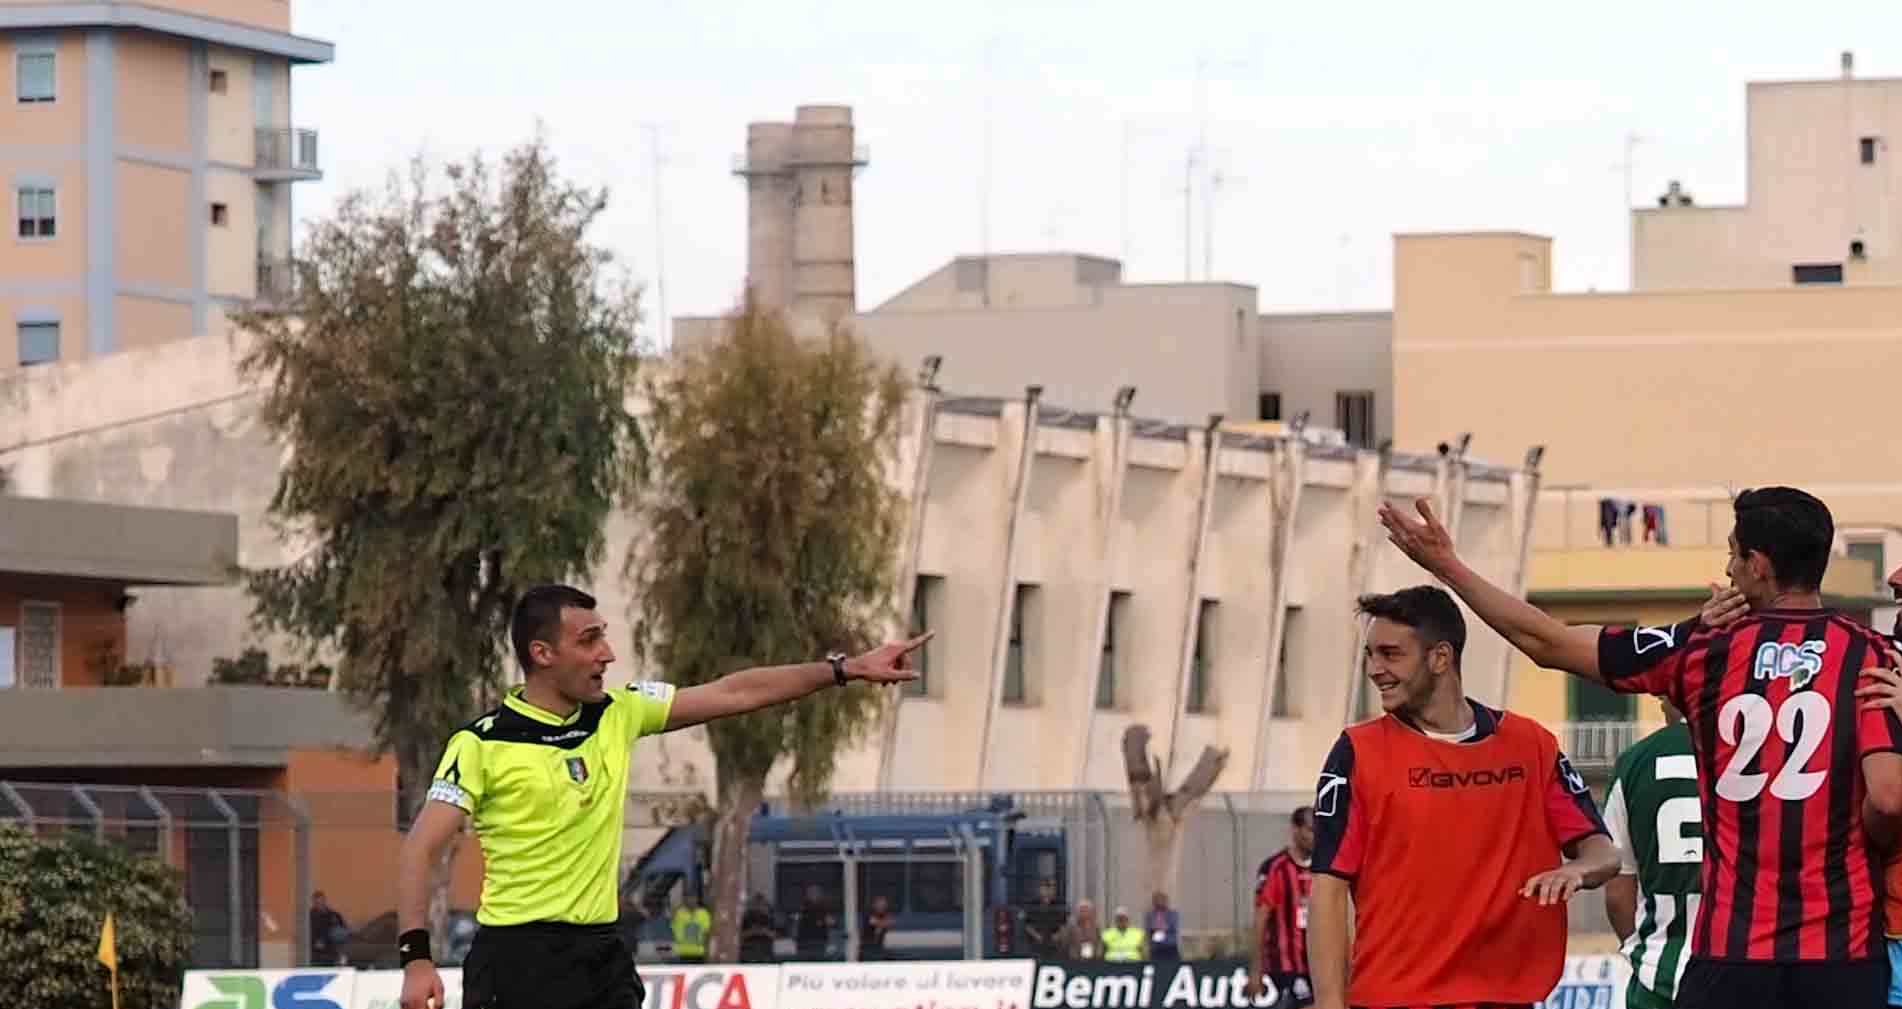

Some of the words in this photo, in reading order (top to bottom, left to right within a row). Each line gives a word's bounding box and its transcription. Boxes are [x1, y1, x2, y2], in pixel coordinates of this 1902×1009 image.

[1715, 690, 1832, 801] 22
[1431, 766, 1525, 788] GIVOVA
[1034, 965, 1155, 1009] Bemi
[1162, 965, 1279, 1009] Auto
